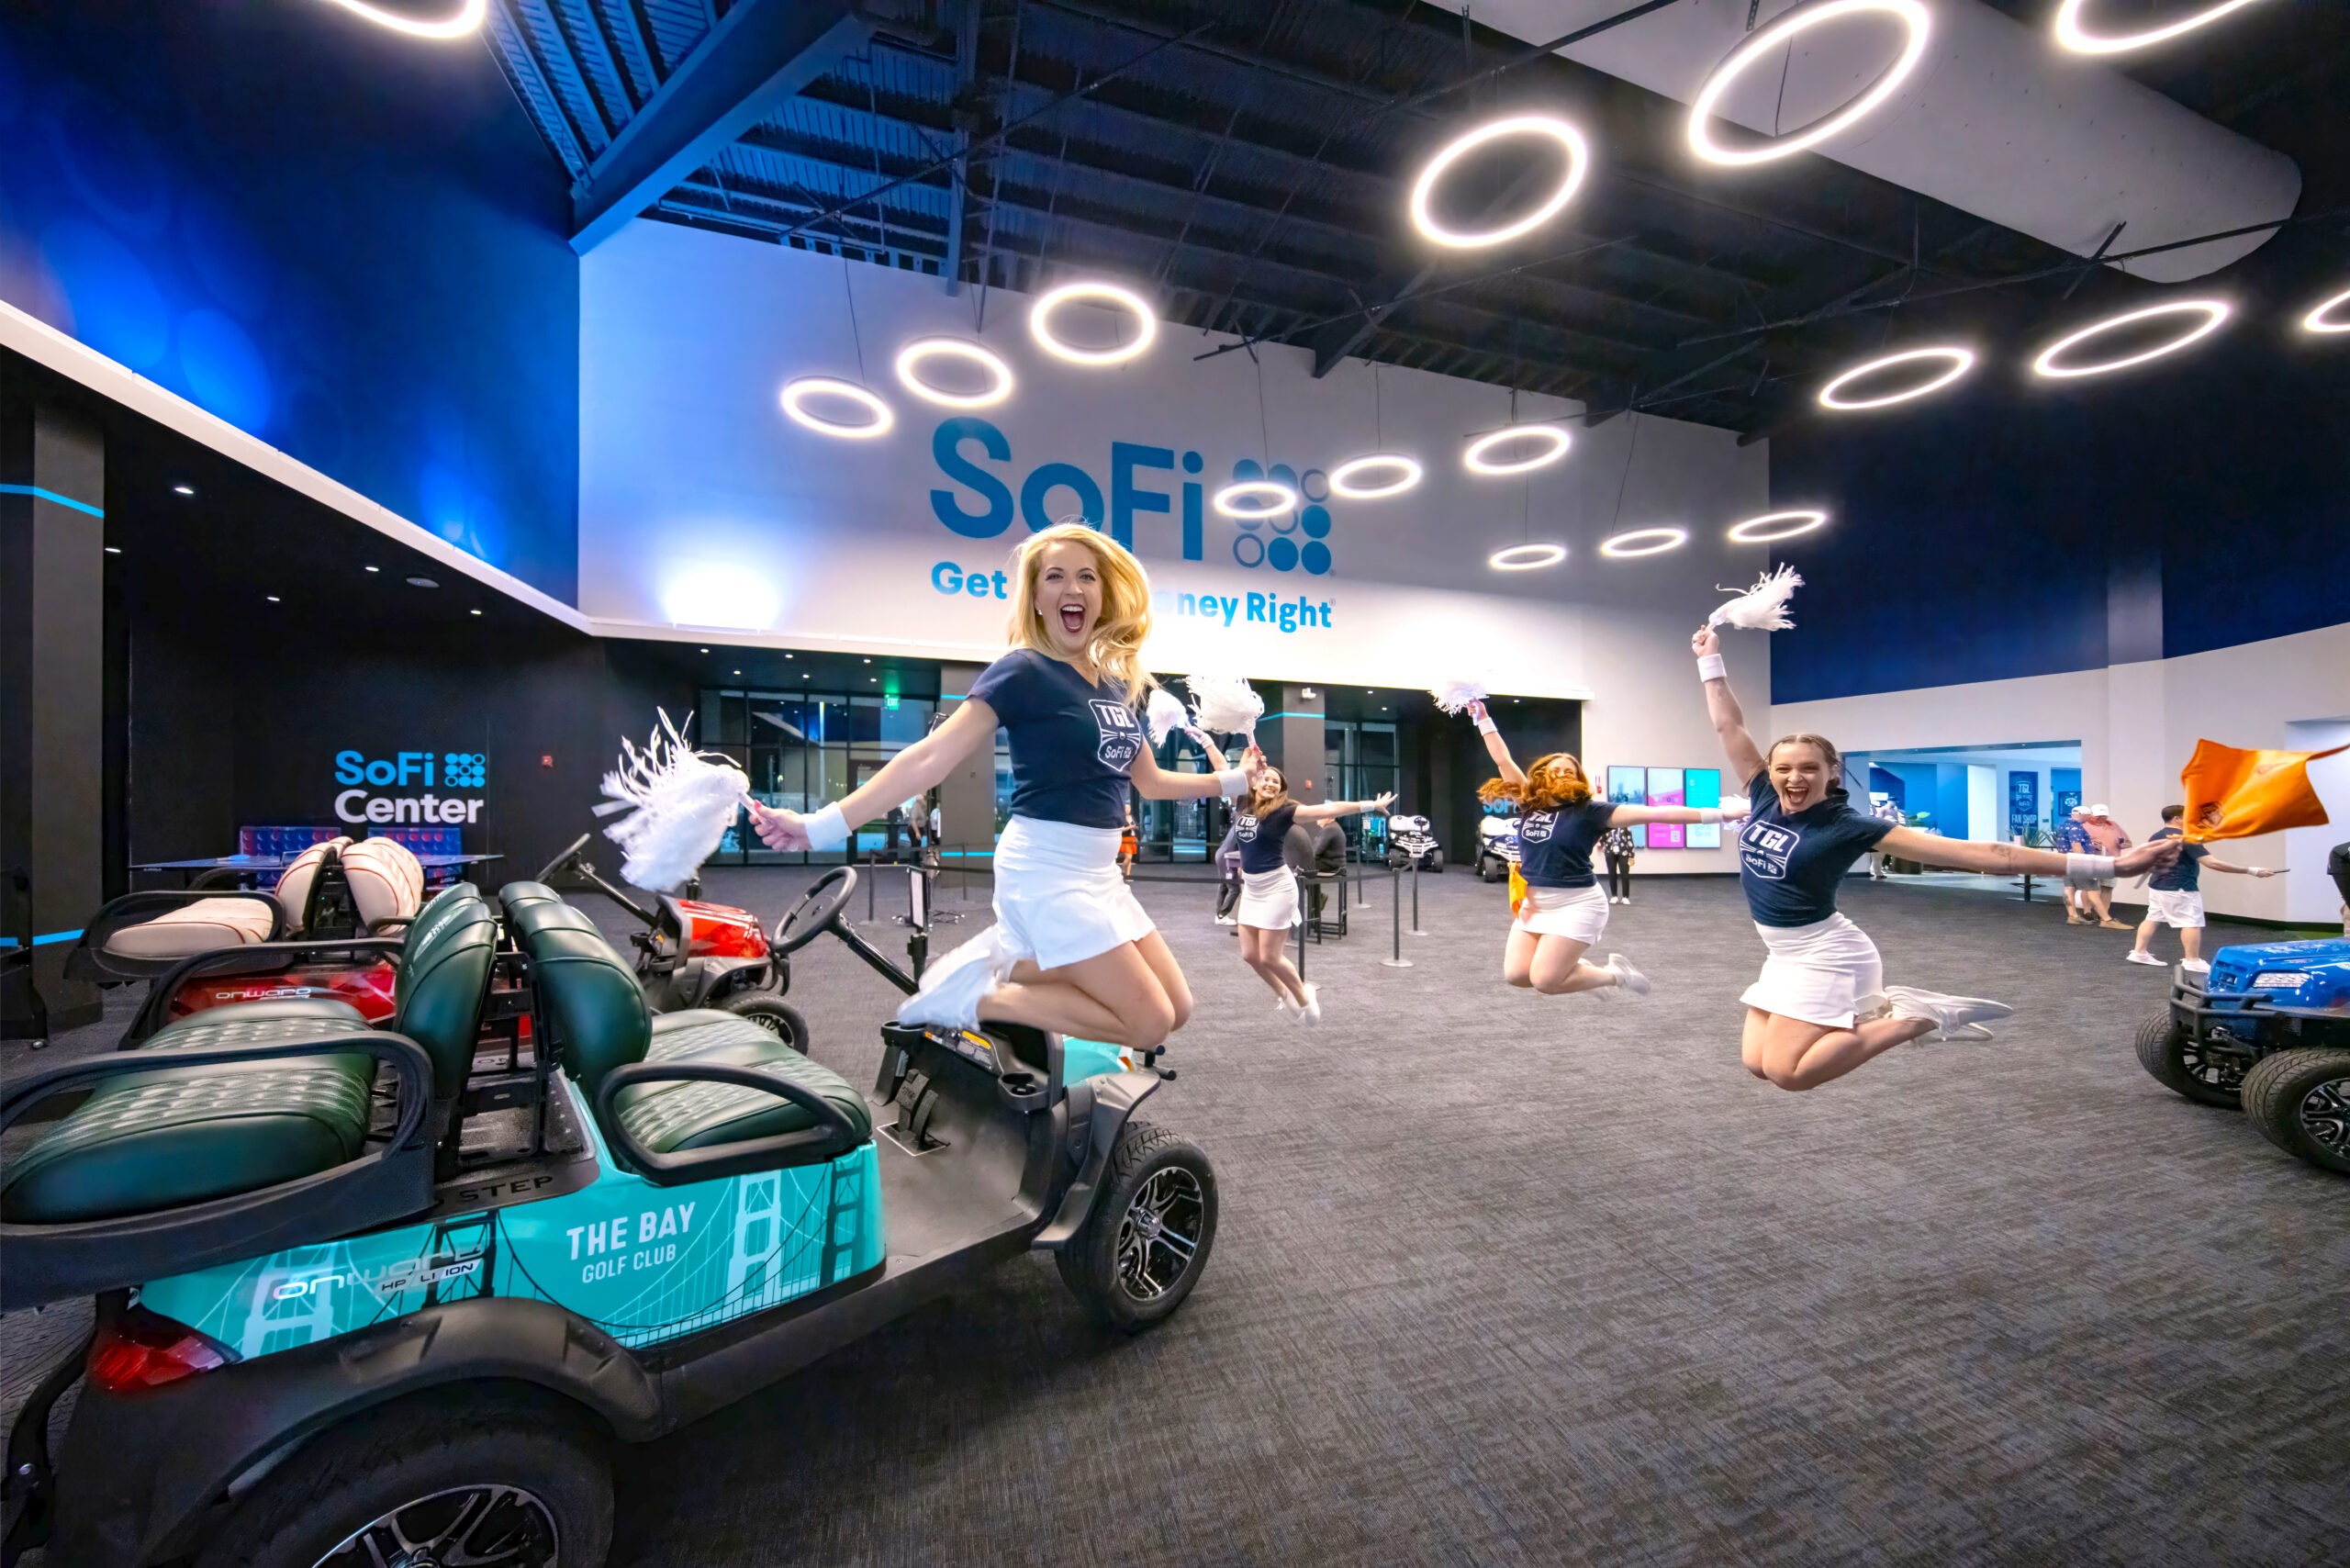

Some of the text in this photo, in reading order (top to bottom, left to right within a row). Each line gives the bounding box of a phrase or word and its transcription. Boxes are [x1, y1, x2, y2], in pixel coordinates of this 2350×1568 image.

[930, 416, 1203, 561] SoFi
[931, 561, 1331, 633] Get ney Right
[1095, 704, 1135, 728] TGL
[1104, 745, 1125, 759] SoFi
[334, 750, 434, 787] SoFi
[334, 789, 484, 824] Center
[1749, 823, 1789, 853] TGL
[1745, 853, 1766, 869] SoFi
[461, 1176, 553, 1203] STEP
[566, 1201, 696, 1260] THE BAY
[582, 1243, 677, 1283] GOLF CLUB
[382, 1279, 407, 1292] HP
